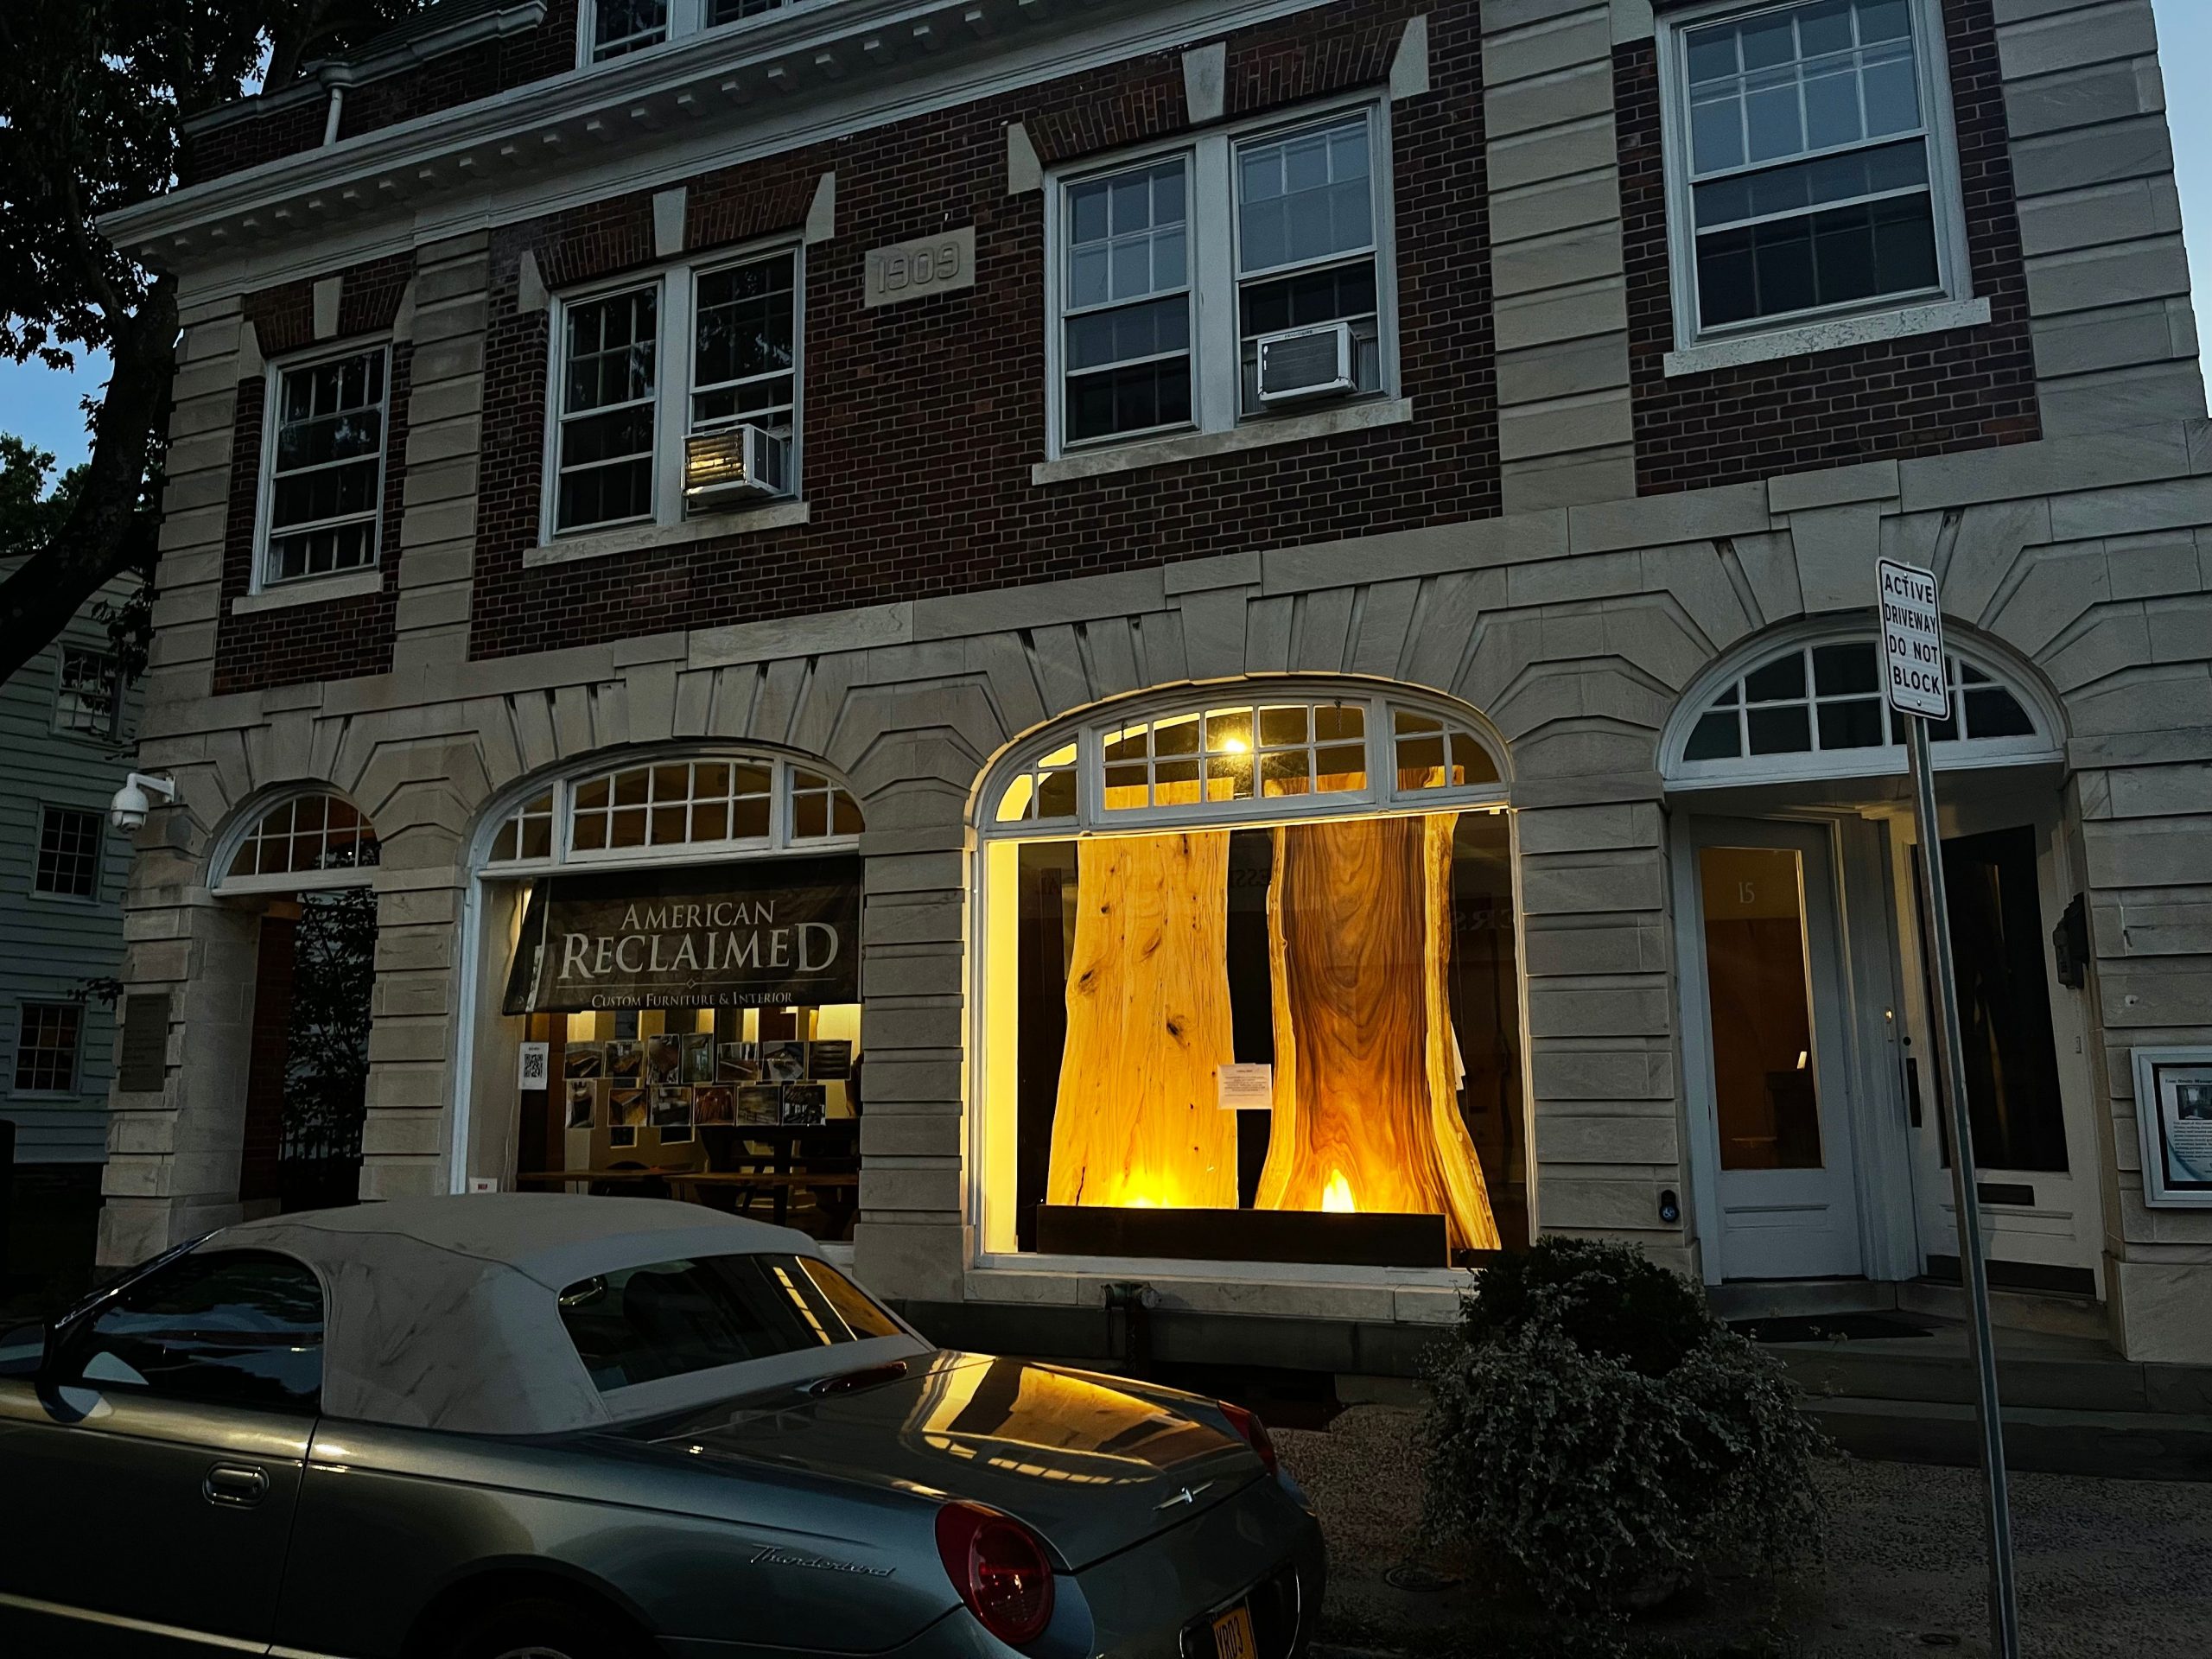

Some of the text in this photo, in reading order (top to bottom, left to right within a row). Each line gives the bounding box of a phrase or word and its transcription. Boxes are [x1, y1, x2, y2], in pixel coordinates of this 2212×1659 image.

[877, 241, 960, 294] 1909
[1885, 573, 1934, 604] ACTIVE
[1885, 603, 1936, 635] DRIVEWAY
[1889, 634, 1938, 665] DO NOT
[1893, 665, 1942, 696] BLOCK
[1738, 881, 1755, 904] 15
[619, 899, 776, 931] AMERICAN
[557, 921, 840, 980] RECLAIMED
[591, 991, 793, 1008] CUSTOM FURNITURE & INTERIOR
[750, 1543, 897, 1579] Thunderbird
